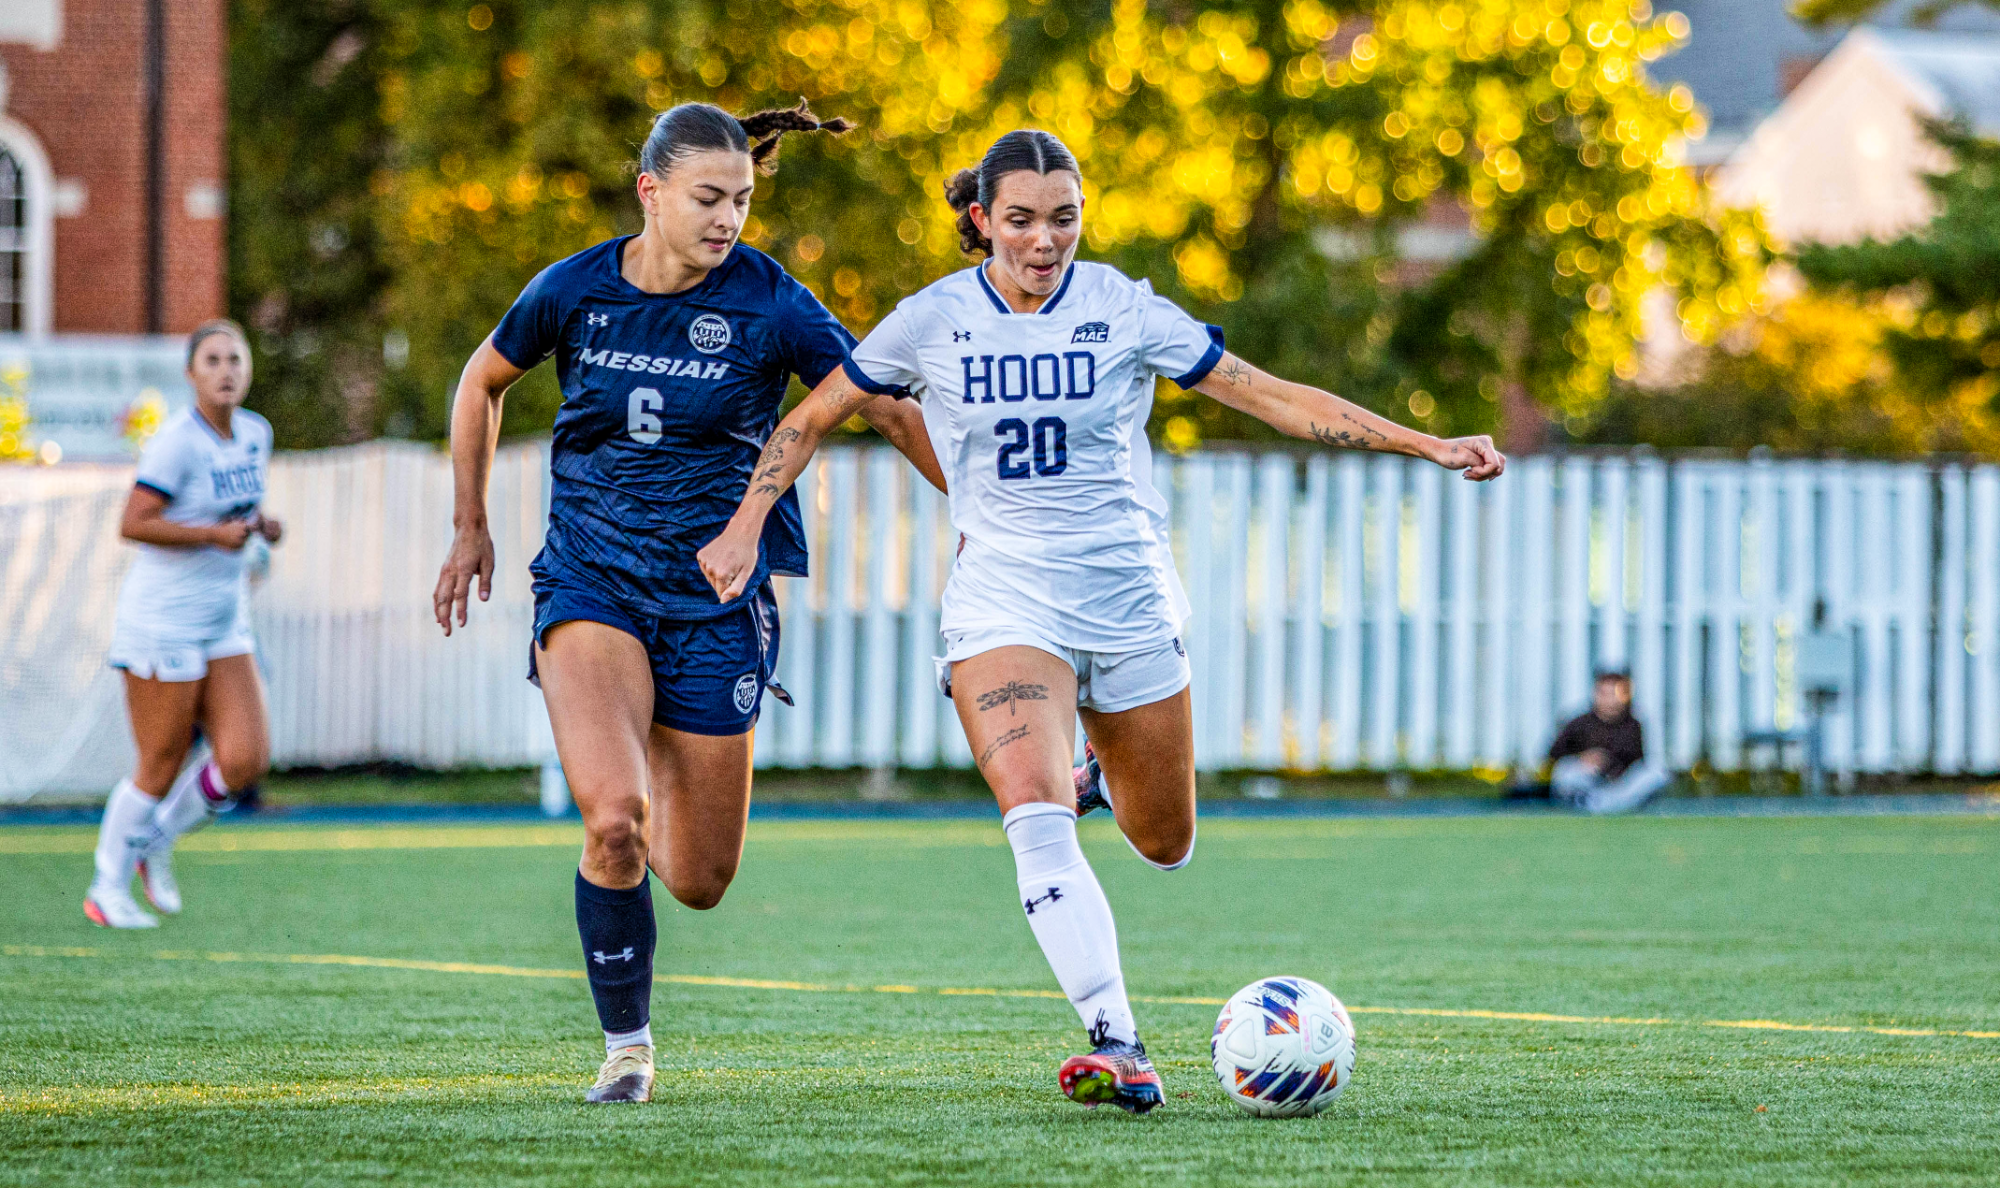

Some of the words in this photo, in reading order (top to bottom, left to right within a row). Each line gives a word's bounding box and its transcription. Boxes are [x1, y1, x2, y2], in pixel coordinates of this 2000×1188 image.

[1073, 331, 1107, 342] MAC
[579, 348, 730, 380] MESSIAH
[961, 351, 1096, 404] HOOD
[627, 387, 664, 445] 6
[994, 416, 1067, 480] 20
